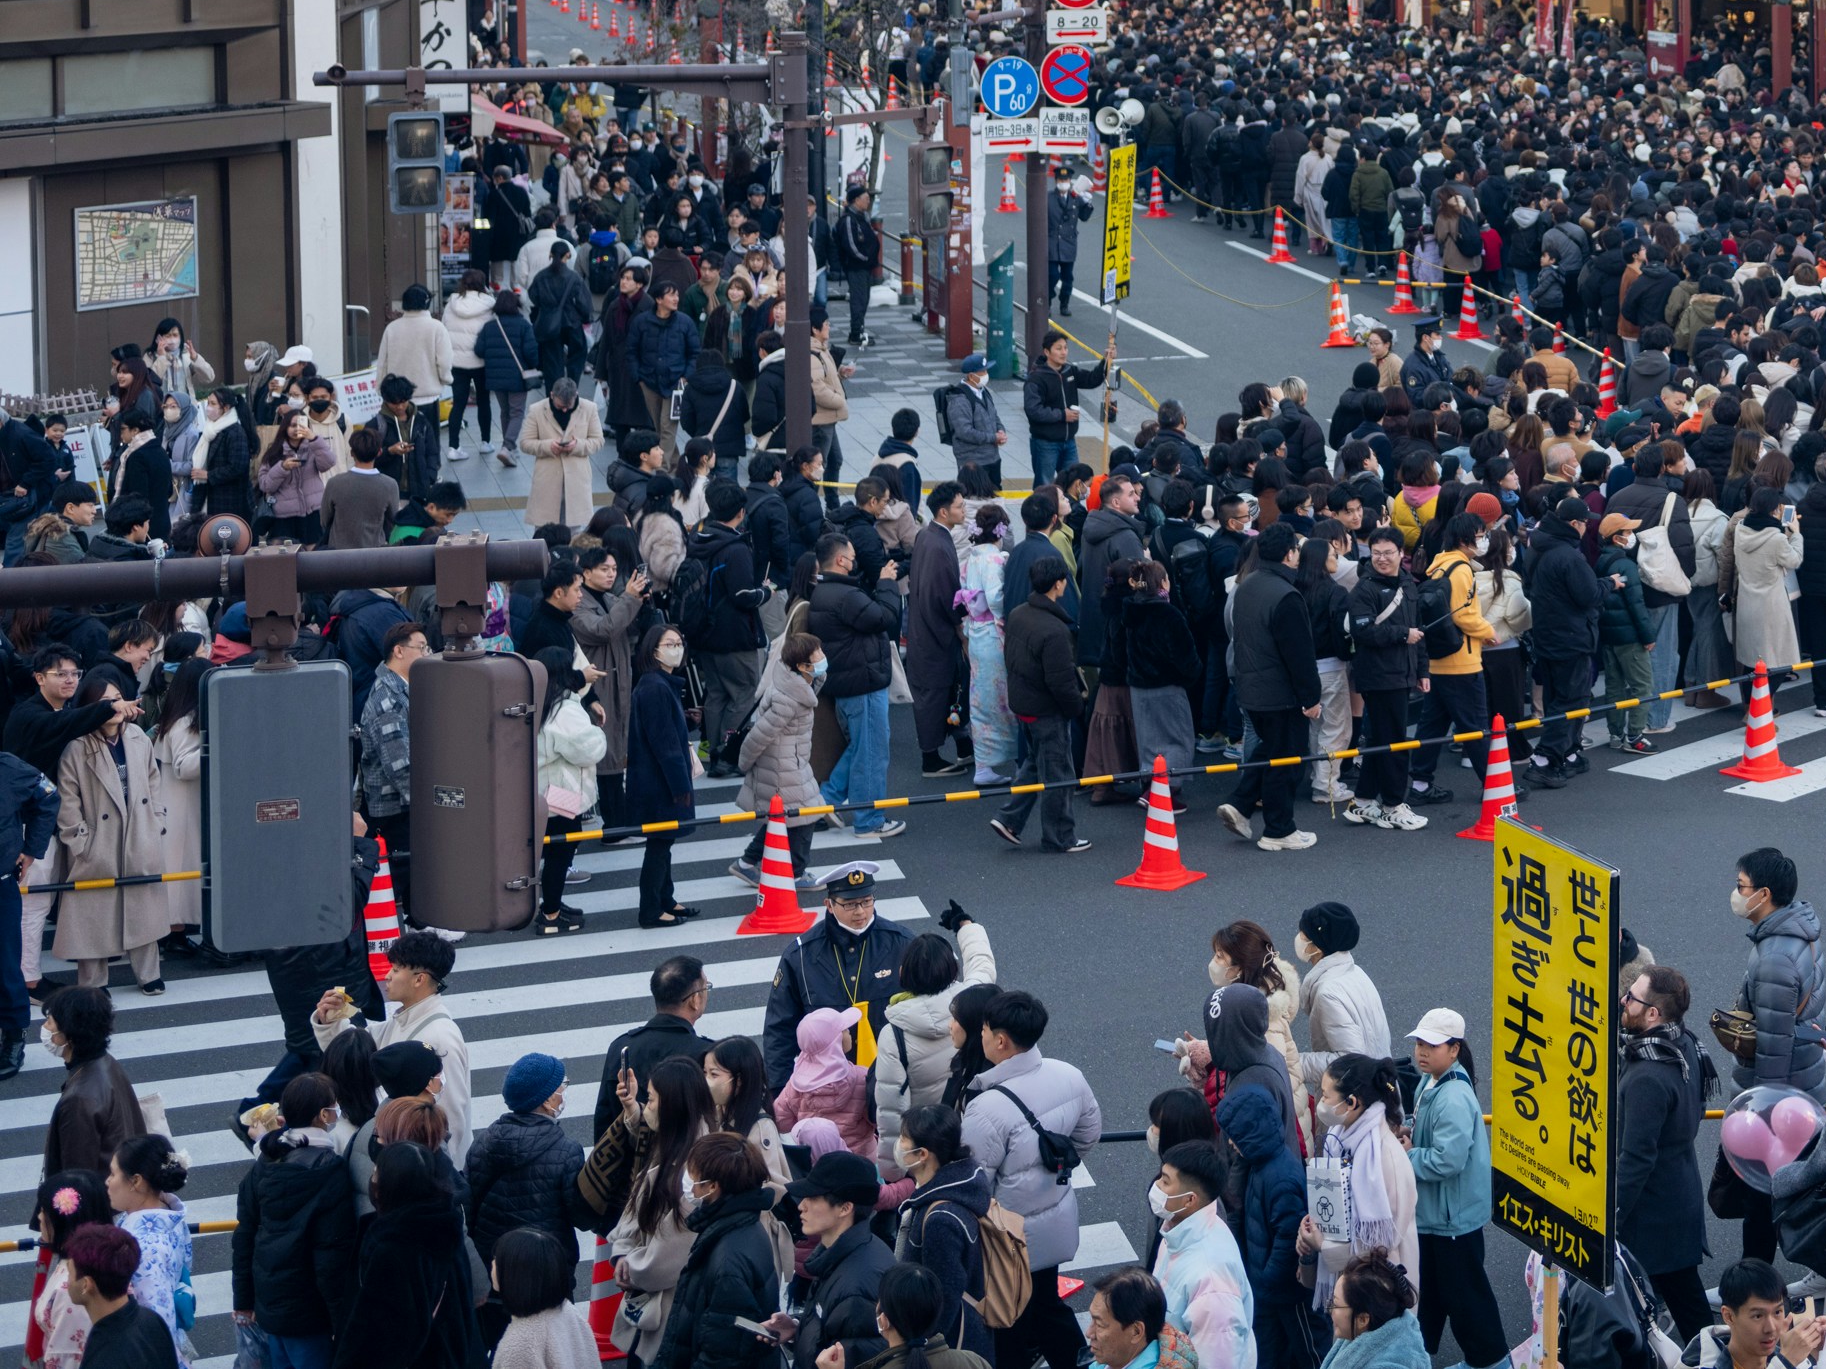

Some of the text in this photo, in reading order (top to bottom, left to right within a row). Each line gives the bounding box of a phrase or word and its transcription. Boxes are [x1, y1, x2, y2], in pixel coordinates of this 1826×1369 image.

[998, 61, 1022, 71] 9-19
[994, 74, 1026, 112] P 60
[1501, 845, 1553, 1145] 過ぎ去る。
[1567, 868, 1600, 1177] 世と世の欲は
[1499, 1127, 1535, 1156] The World and
[1509, 1144, 1527, 1163] Desires
[1527, 1157, 1537, 1168] are
[1537, 1162, 1556, 1181] passing
[1556, 1173, 1571, 1190] away.
[1498, 1191, 1590, 1268] イエス・キリスト
